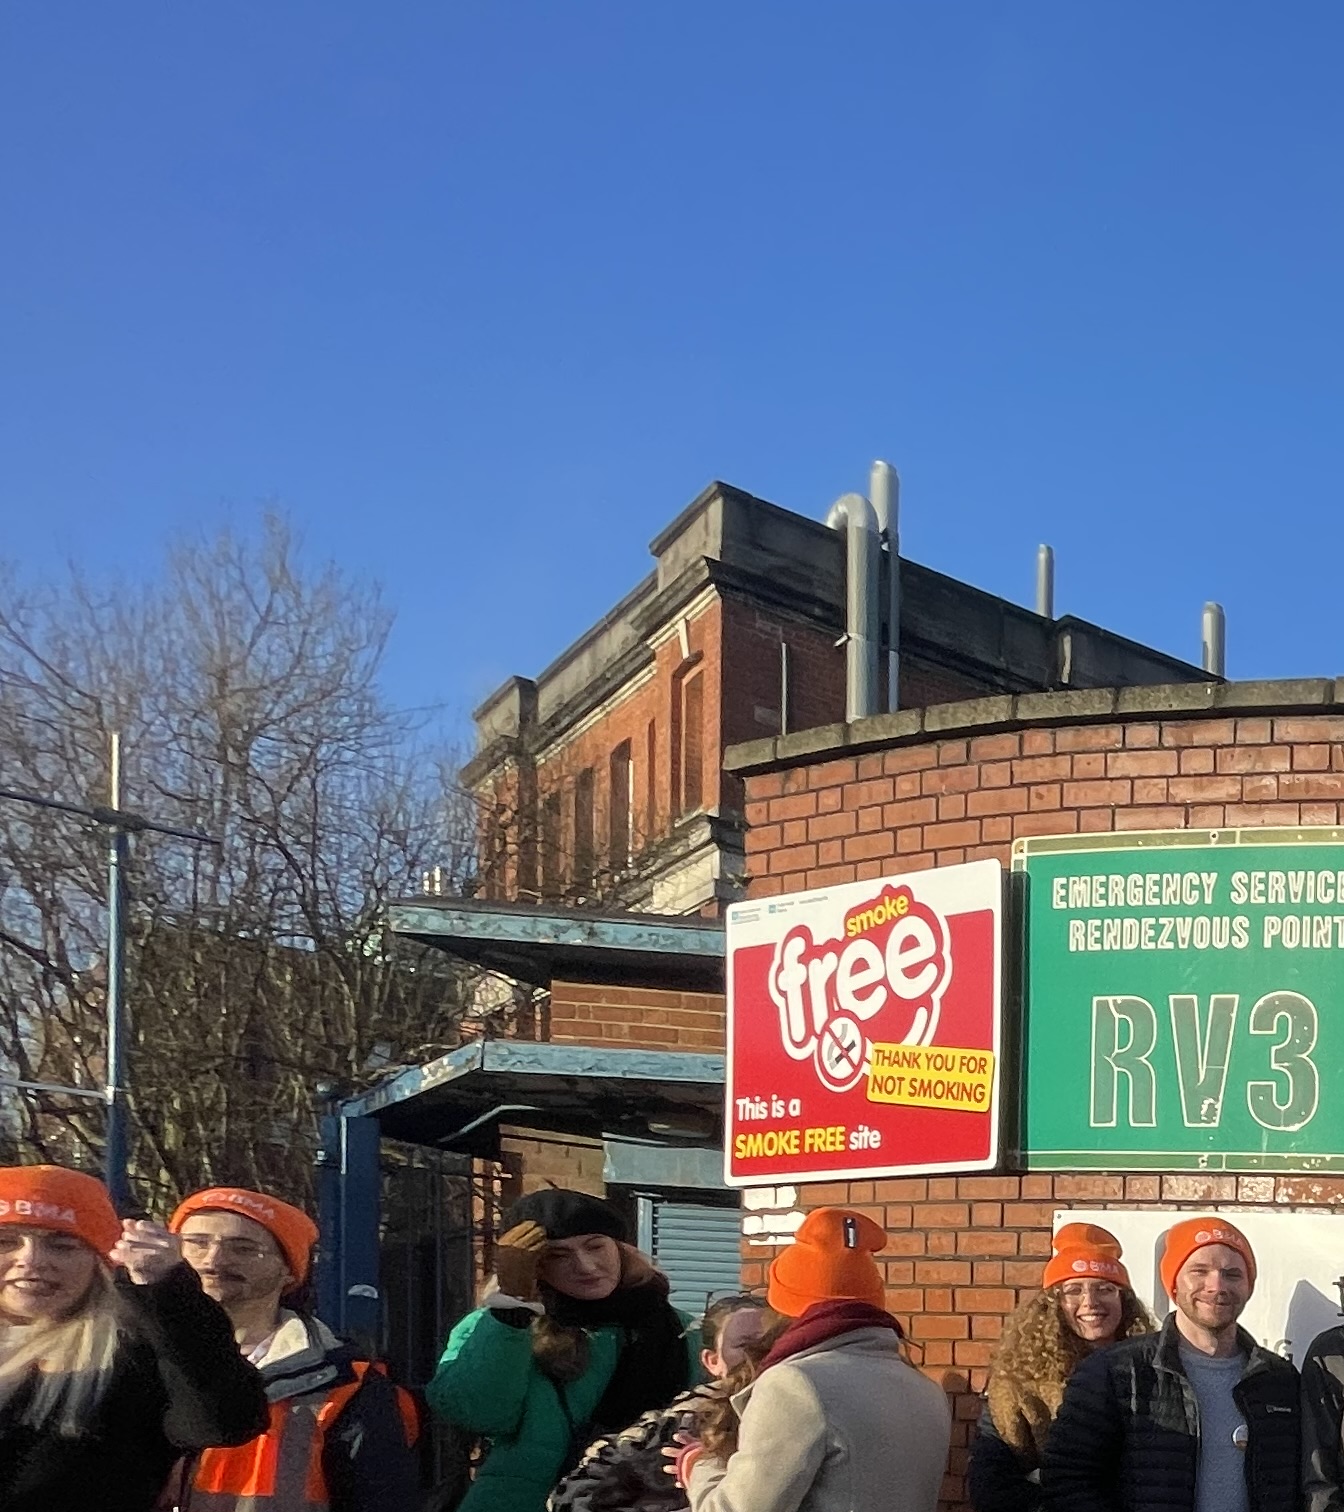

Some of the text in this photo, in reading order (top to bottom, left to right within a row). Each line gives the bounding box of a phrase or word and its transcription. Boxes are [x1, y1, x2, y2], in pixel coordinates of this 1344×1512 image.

[1052, 872, 1218, 909] EMERGENCY
[846, 894, 909, 938] smoke
[1069, 916, 1250, 951] RENDEZVOUS
[778, 915, 938, 1043] free
[874, 1049, 987, 1074] THANK YOU FOR
[1090, 990, 1319, 1131] RV3
[871, 1075, 986, 1103] NOT SMOKING
[736, 1094, 801, 1121] This is a
[735, 1124, 882, 1159] SMOKE FREE site
